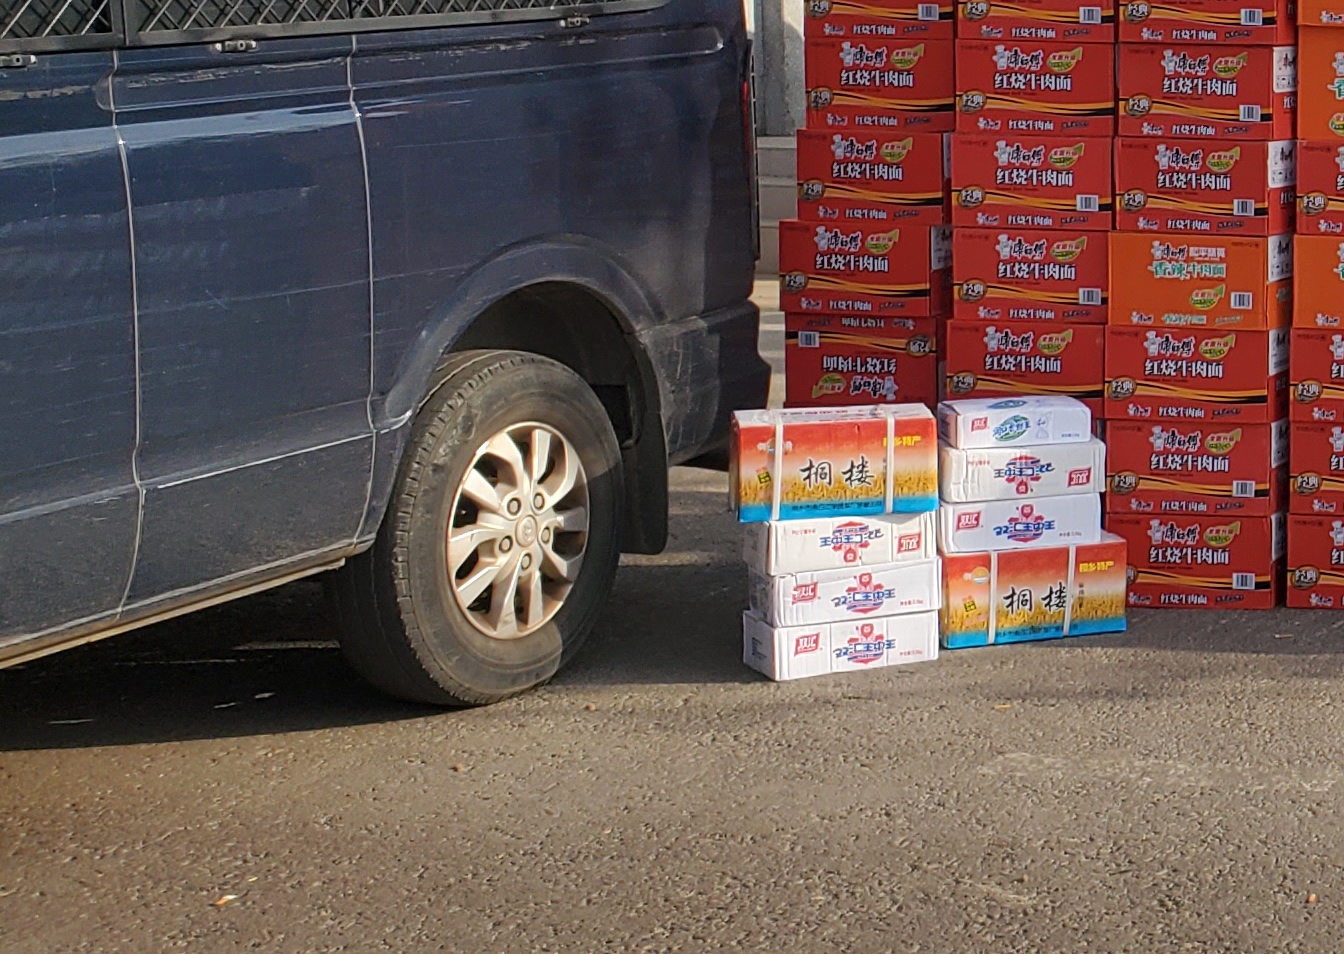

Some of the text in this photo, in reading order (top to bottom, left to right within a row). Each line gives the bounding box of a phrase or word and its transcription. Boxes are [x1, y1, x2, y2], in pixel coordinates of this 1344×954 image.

[841, 70, 913, 87] 红烧牛肉面
[995, 74, 1071, 91] 红烧牛肉面
[1163, 78, 1236, 96] 红烧牛肉面
[833, 163, 903, 181] 红烧牛肉面
[997, 170, 1073, 187] 红烧牛肉面
[1158, 172, 1230, 190] 红烧牛肉面
[816, 255, 888, 272] 红烧牛肉面
[998, 263, 1076, 280] 红烧牛肉面
[1148, 262, 1225, 280] 香辣牛肉面
[985, 356, 1061, 373] 红烧牛肉面
[1145, 360, 1223, 378] 红烧牛肉面
[1151, 454, 1229, 472] 红烧牛肉面
[1150, 548, 1229, 565] 红烧牛肉面
